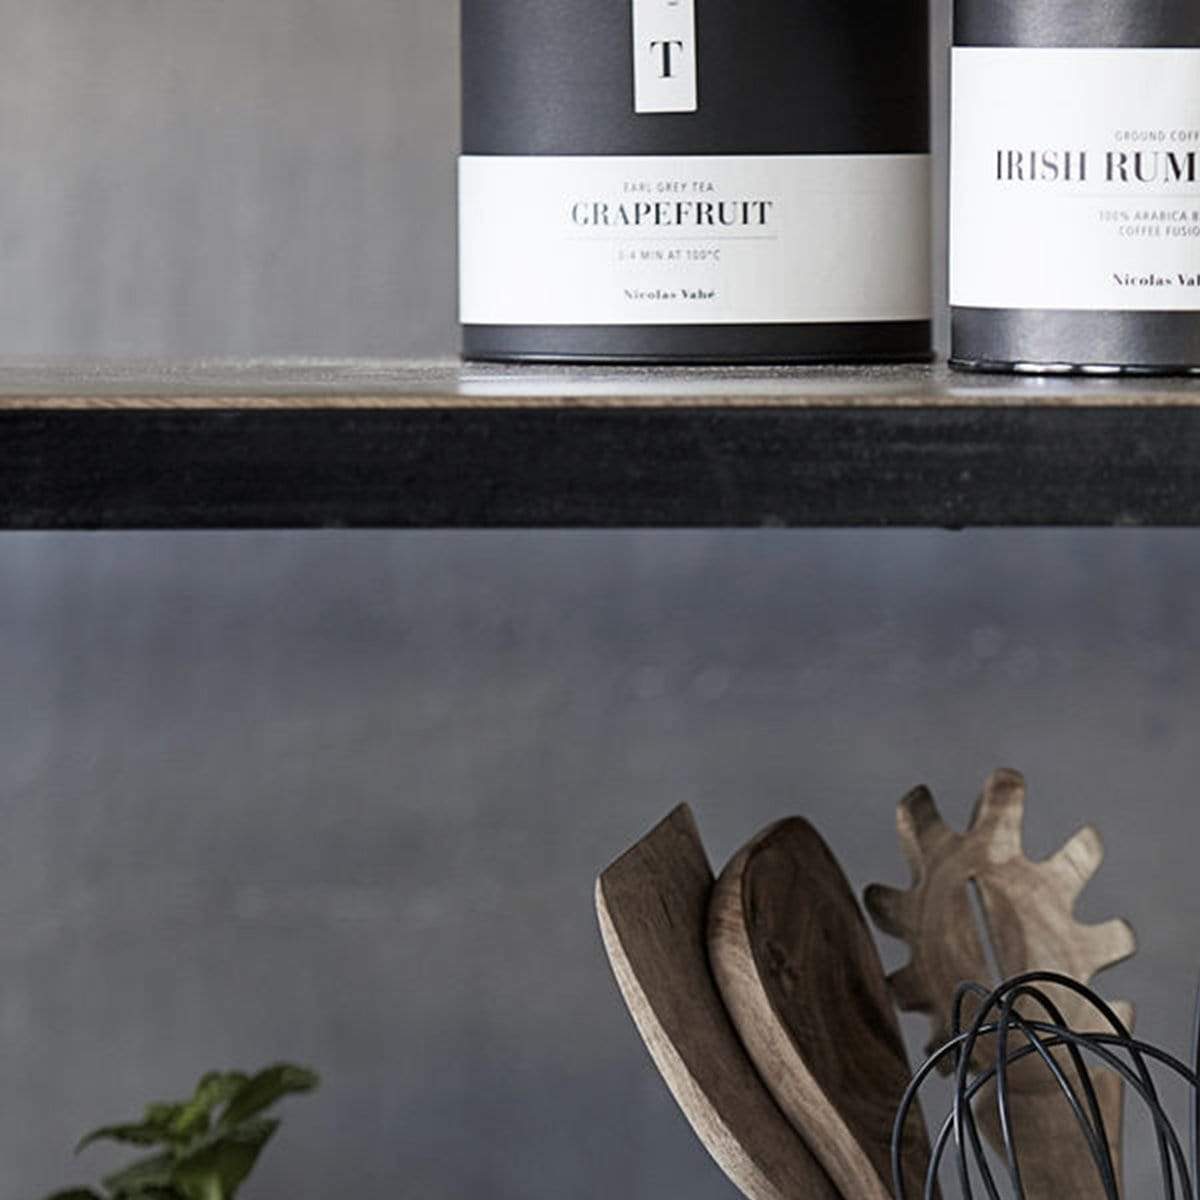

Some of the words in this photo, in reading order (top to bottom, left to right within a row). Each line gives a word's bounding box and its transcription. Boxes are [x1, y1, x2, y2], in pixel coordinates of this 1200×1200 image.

[1114, 130, 1166, 141] GROUND
[996, 150, 1086, 182] IRISH
[1105, 151, 1196, 183] RUM
[657, 181, 687, 193] GREY
[693, 181, 714, 193] TEA
[571, 201, 774, 226] GRAPEFRUIT
[1134, 210, 1187, 222] ARABICA
[1119, 226, 1160, 237] COFFEE
[668, 249, 681, 260] AT
[1113, 273, 1172, 286] Nicolas
[624, 288, 676, 300] Nicolas
